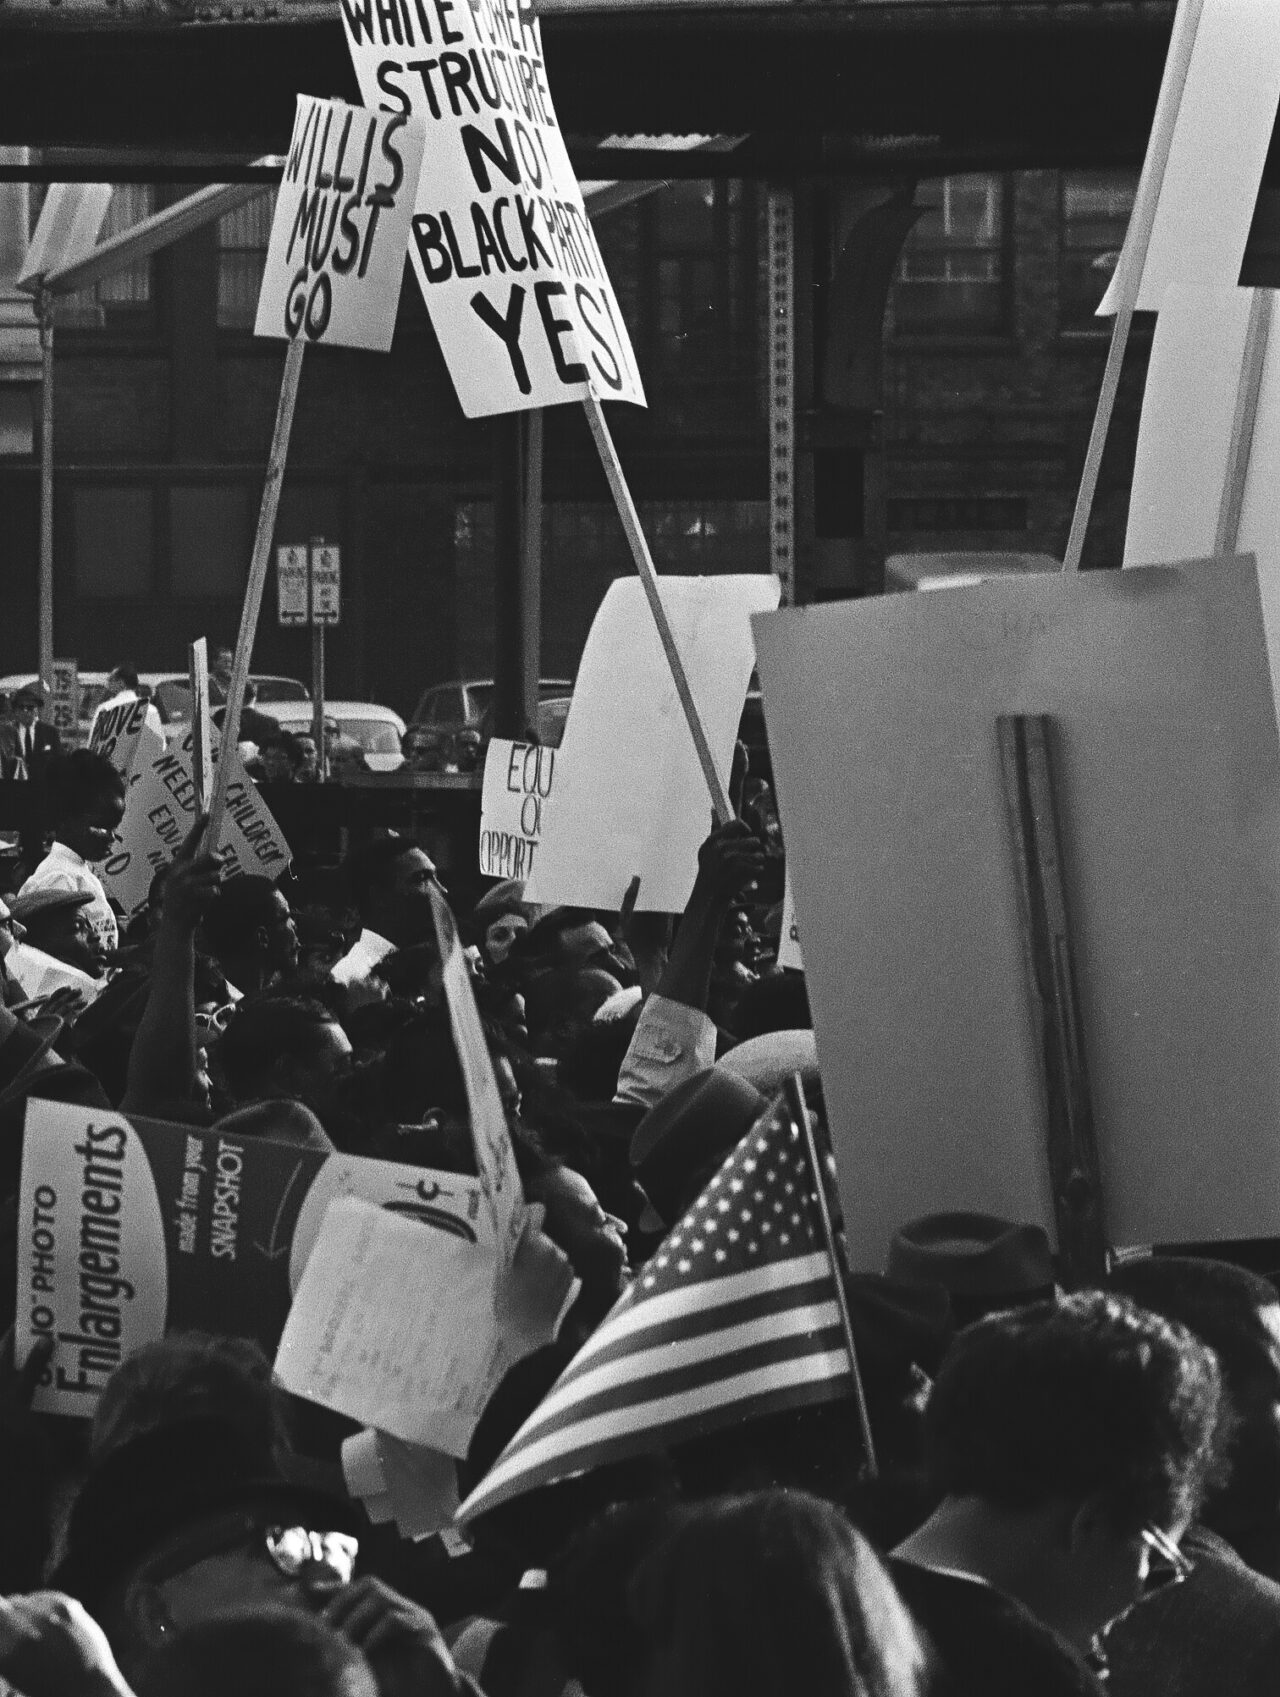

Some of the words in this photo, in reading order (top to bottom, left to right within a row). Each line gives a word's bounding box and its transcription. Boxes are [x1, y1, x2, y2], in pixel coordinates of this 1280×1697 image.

[341, 0, 464, 47] WHITE
[376, 48, 556, 127] STRUCTURE
[287, 101, 408, 196] WILLIS
[285, 187, 396, 279] MUST
[412, 194, 554, 284] BLACK
[538, 195, 606, 282] PARTY
[284, 268, 332, 341] GO
[151, 754, 196, 812] NEED
[225, 782, 285, 866] CHILDREN
[31, 1185, 57, 1293] PHOTO
[210, 1137, 245, 1262] SNAPSHOT
[56, 1122, 136, 1393] Enlargements
